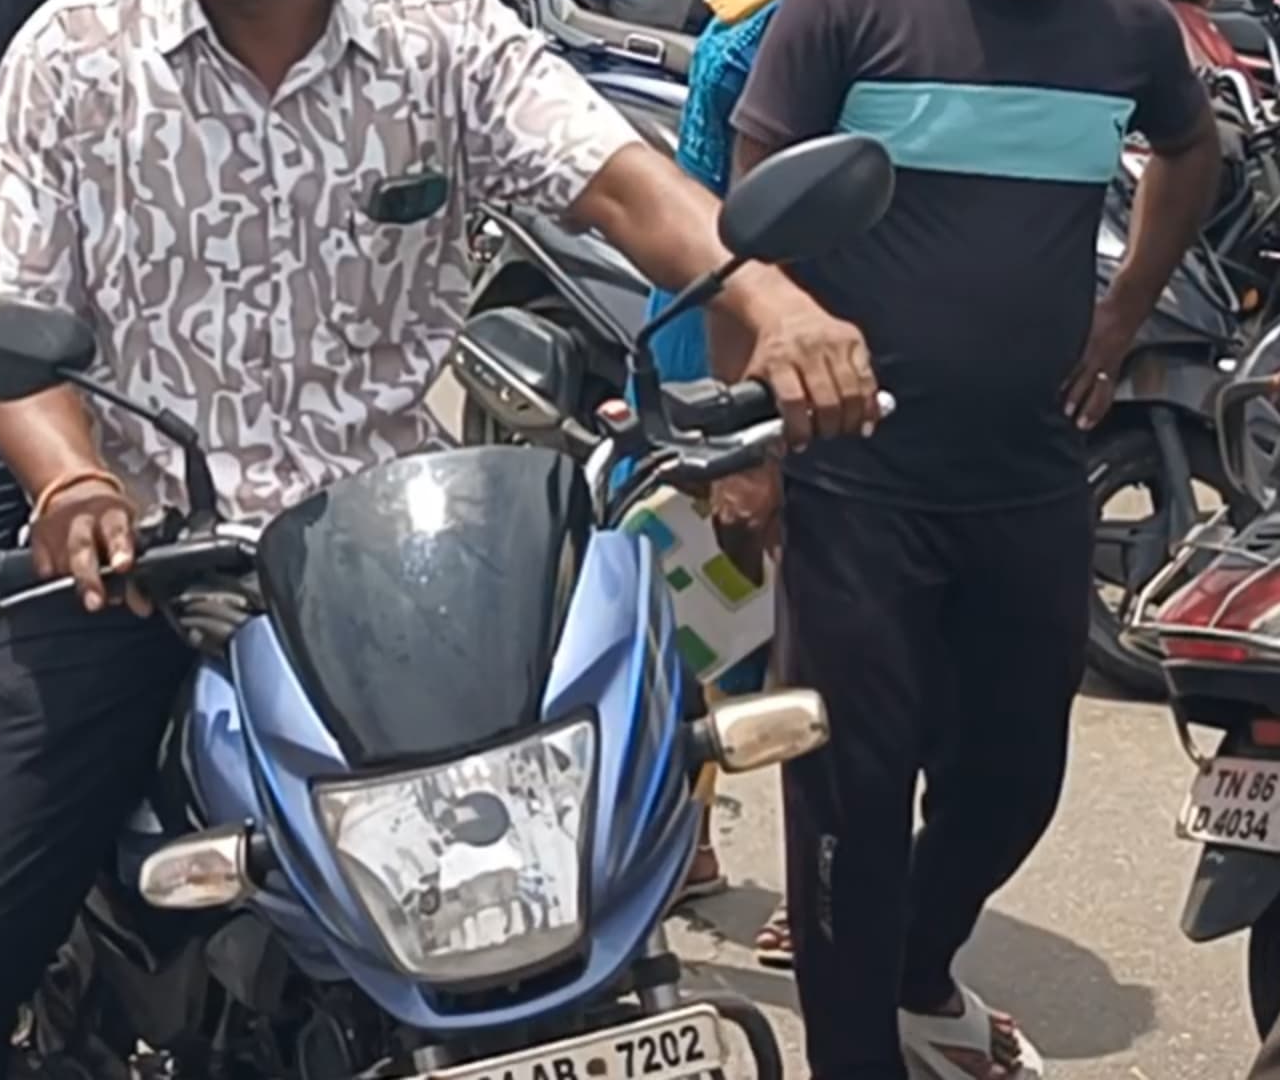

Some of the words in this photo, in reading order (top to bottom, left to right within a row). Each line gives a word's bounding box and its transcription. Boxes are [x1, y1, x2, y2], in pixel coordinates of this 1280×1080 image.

[1214, 771, 1247, 798] TN
[1247, 772, 1278, 802] 86
[615, 1025, 705, 1078] 7202
